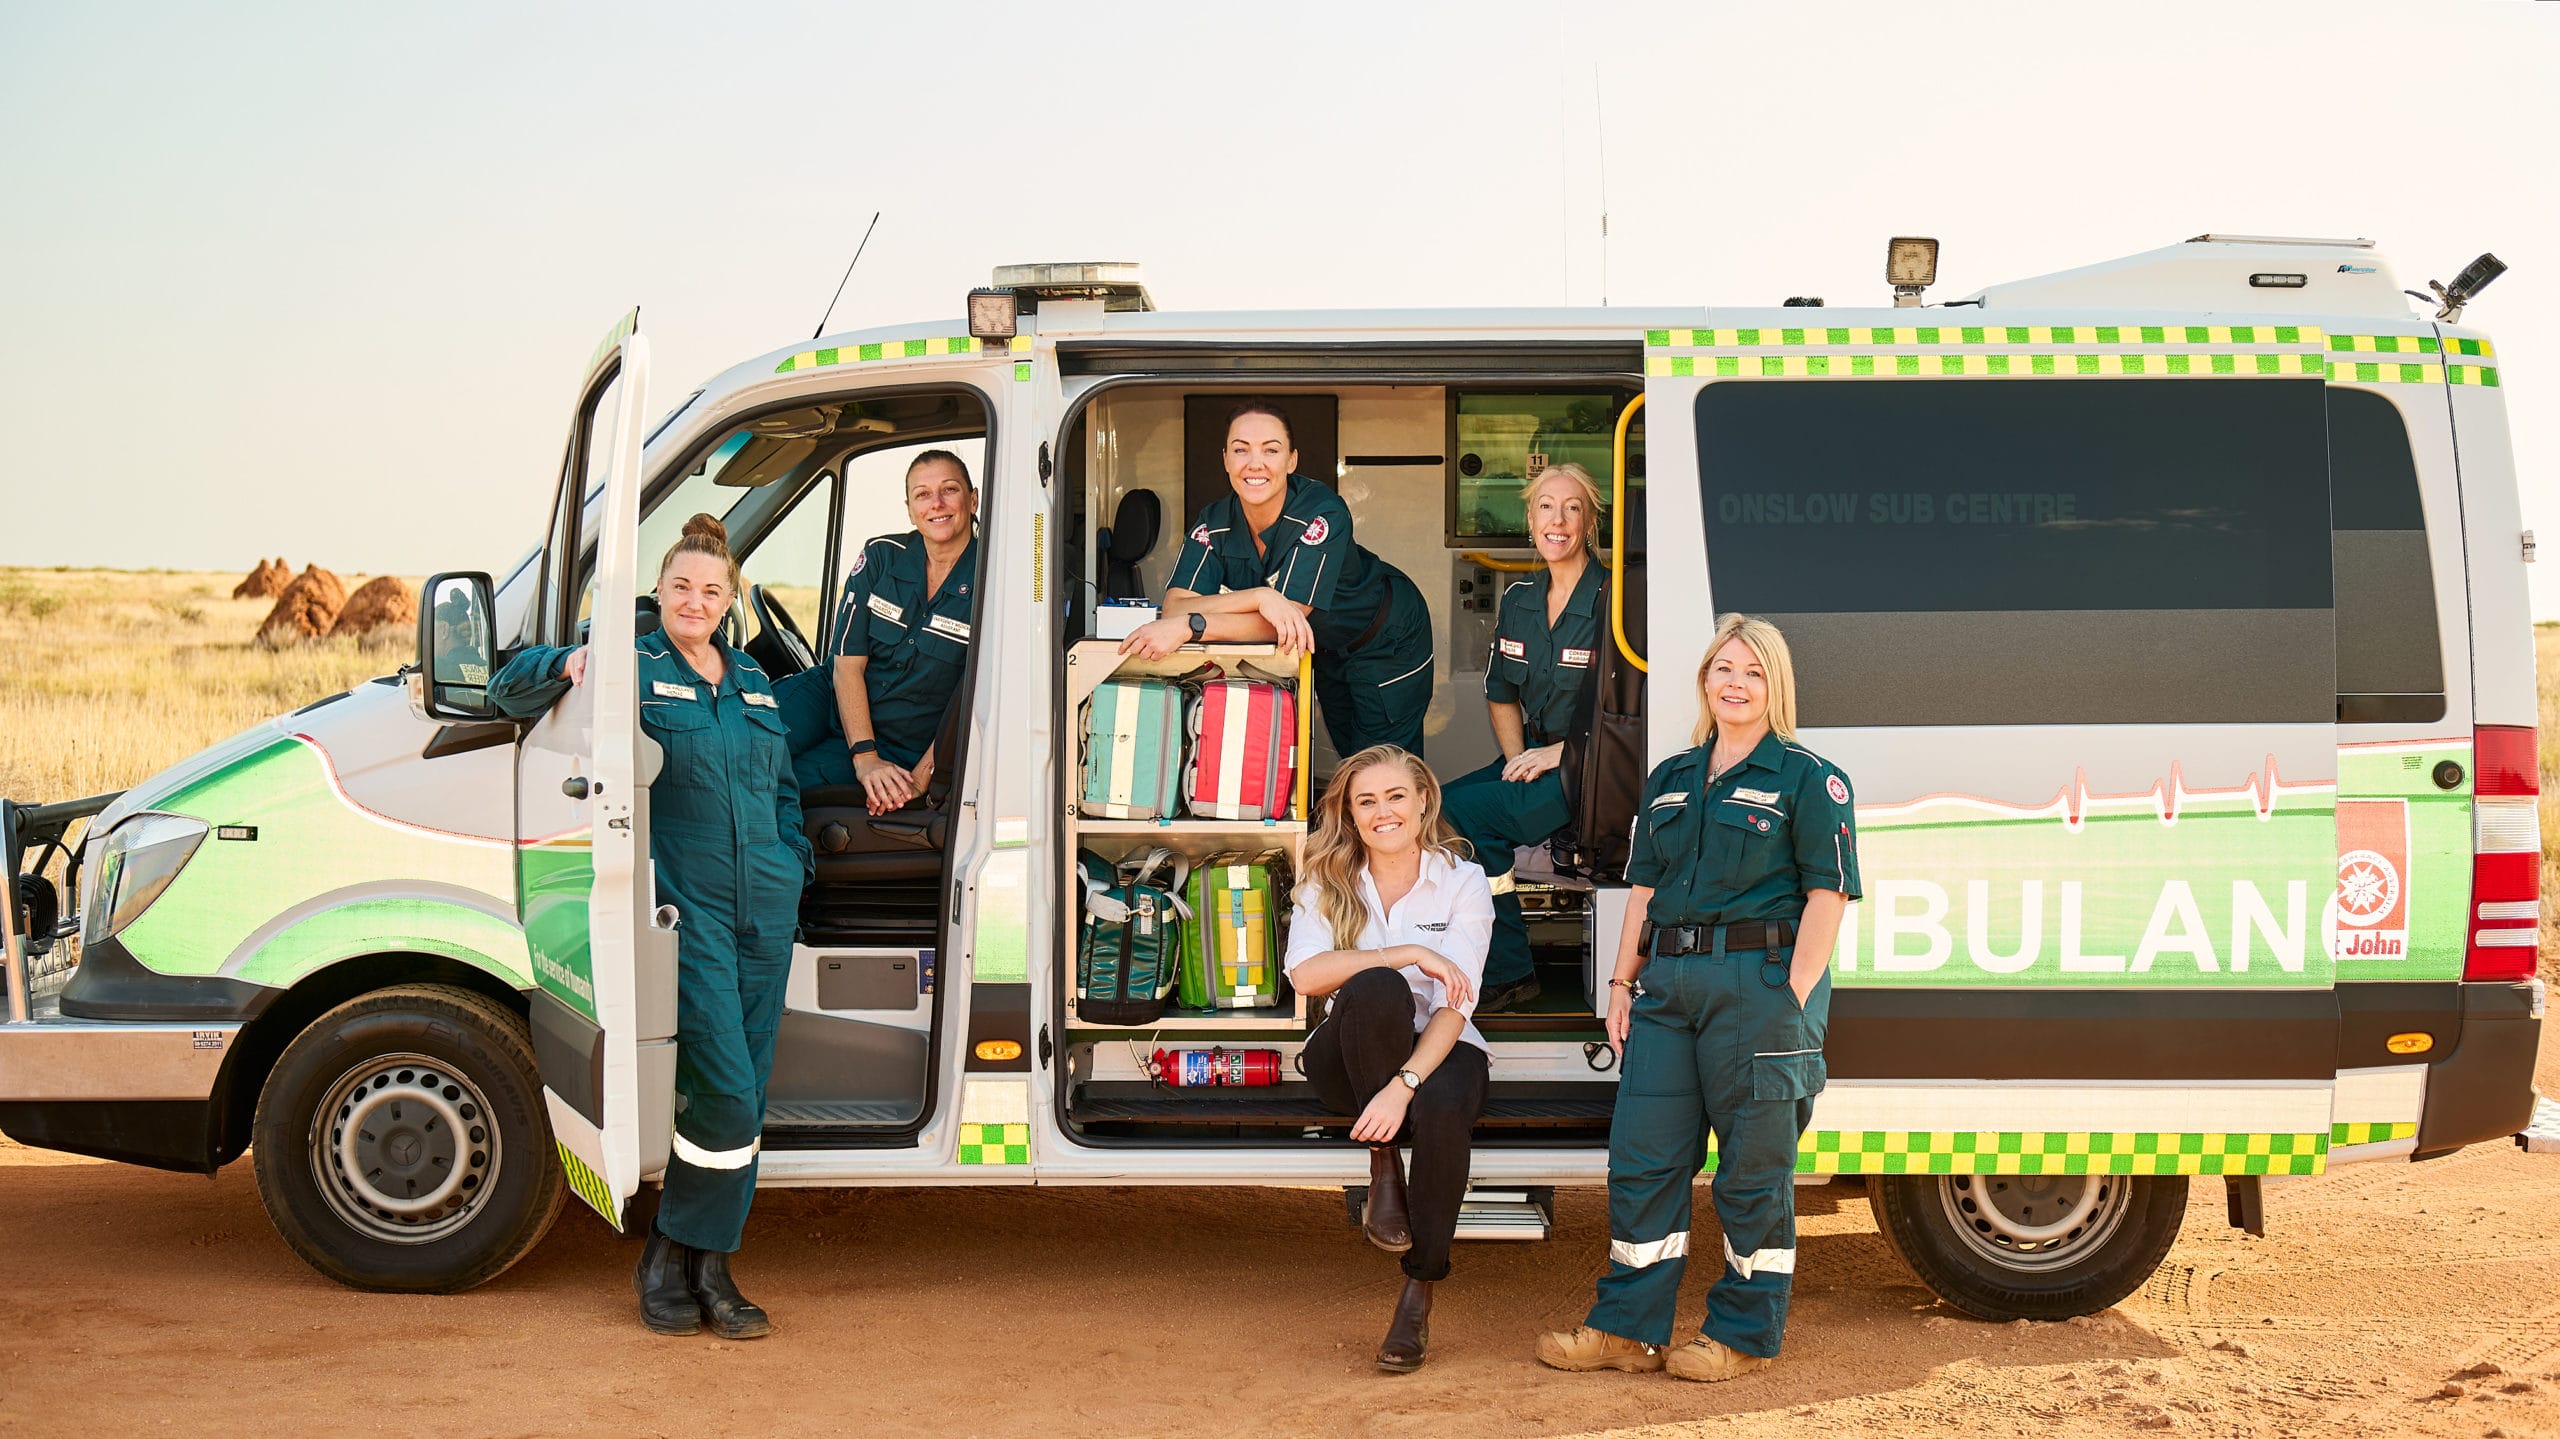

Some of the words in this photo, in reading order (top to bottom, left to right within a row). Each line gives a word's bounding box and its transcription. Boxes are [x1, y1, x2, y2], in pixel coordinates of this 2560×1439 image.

[1530, 455, 1543, 466] 11
[1718, 493, 1858, 524] ONSLOW
[1869, 493, 1935, 524] SUB
[1945, 493, 2077, 524] CENTRE
[1068, 654, 1077, 666] 2
[1067, 804, 1076, 816] 3
[1833, 879, 2337, 973] BULAN
[2346, 931, 2401, 956] John
[533, 943, 542, 970] For
[541, 949, 550, 976] the
[549, 957, 565, 986] service
[570, 965, 593, 1010] humanity
[1067, 997, 1075, 1009] 4
